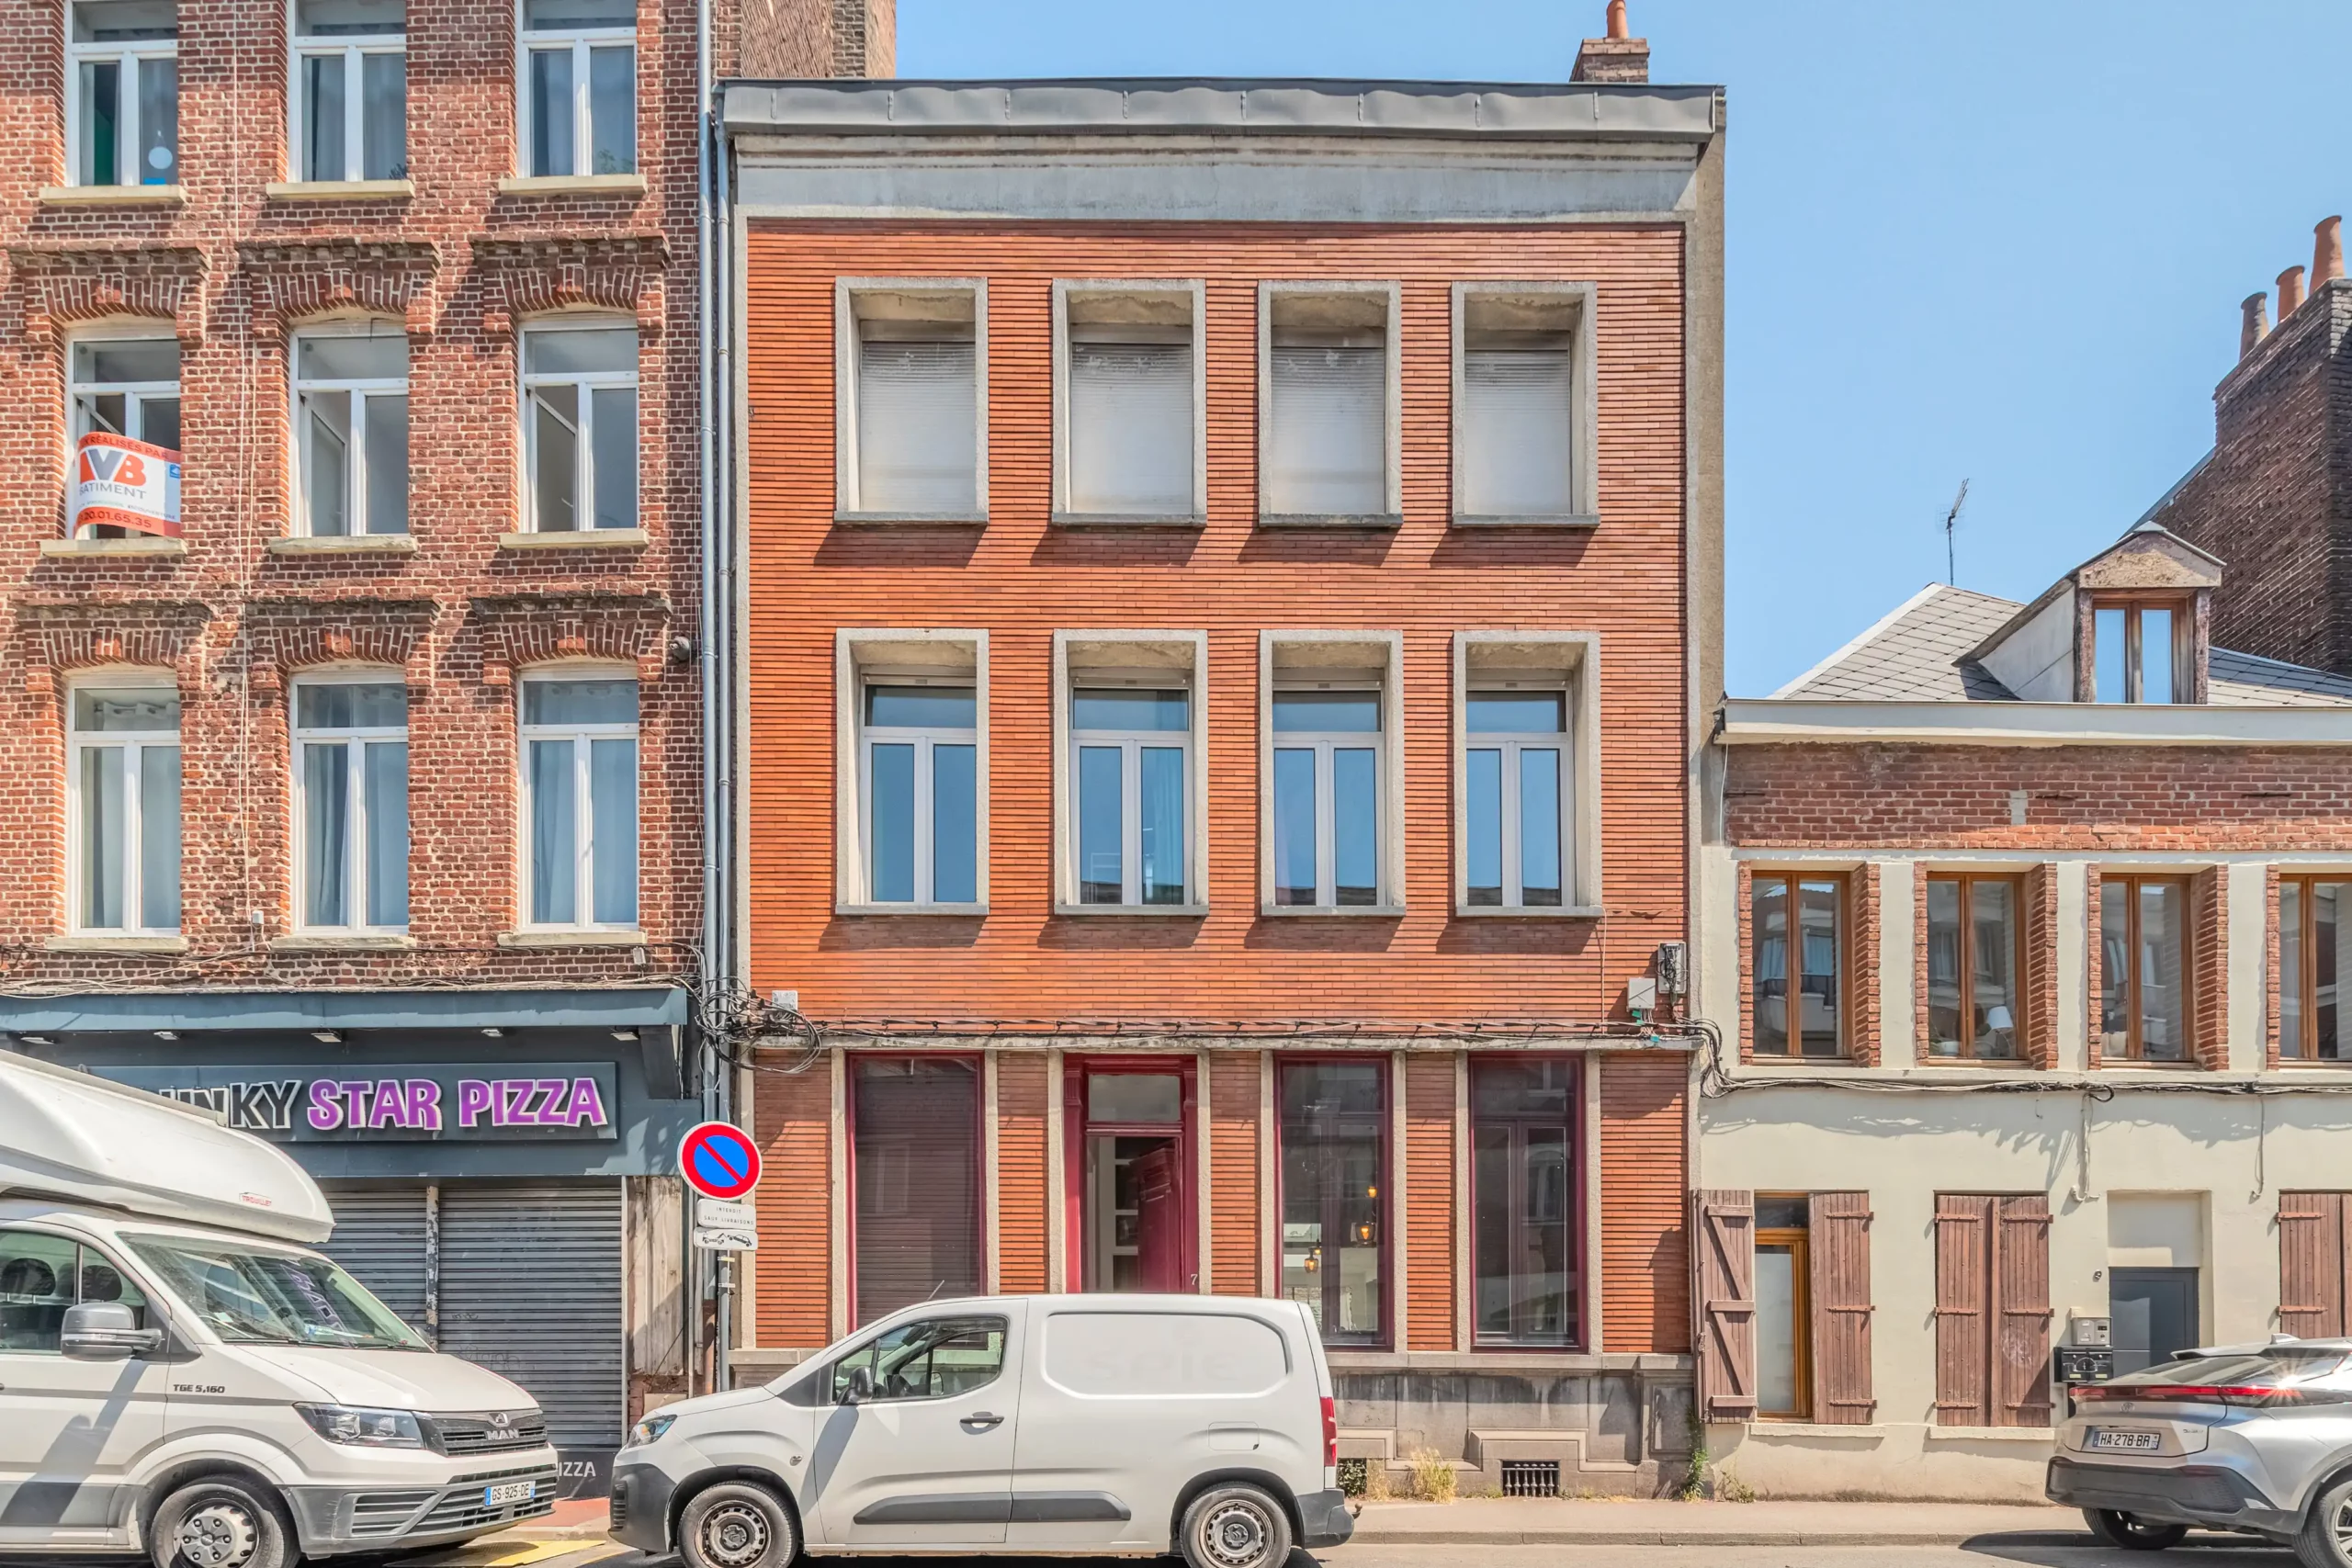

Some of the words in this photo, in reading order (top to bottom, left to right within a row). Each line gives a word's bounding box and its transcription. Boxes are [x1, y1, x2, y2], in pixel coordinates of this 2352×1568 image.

[307, 1078, 443, 1131] STAR
[458, 1077, 608, 1128] PIZZA
[716, 1206, 741, 1214] INTERDIT
[721, 1217, 754, 1225] LIVRAISONS
[1190, 1273, 1198, 1286] 7
[173, 1383, 194, 1393] TGE
[485, 1428, 520, 1441] MAN
[558, 1461, 596, 1477] IZZA
